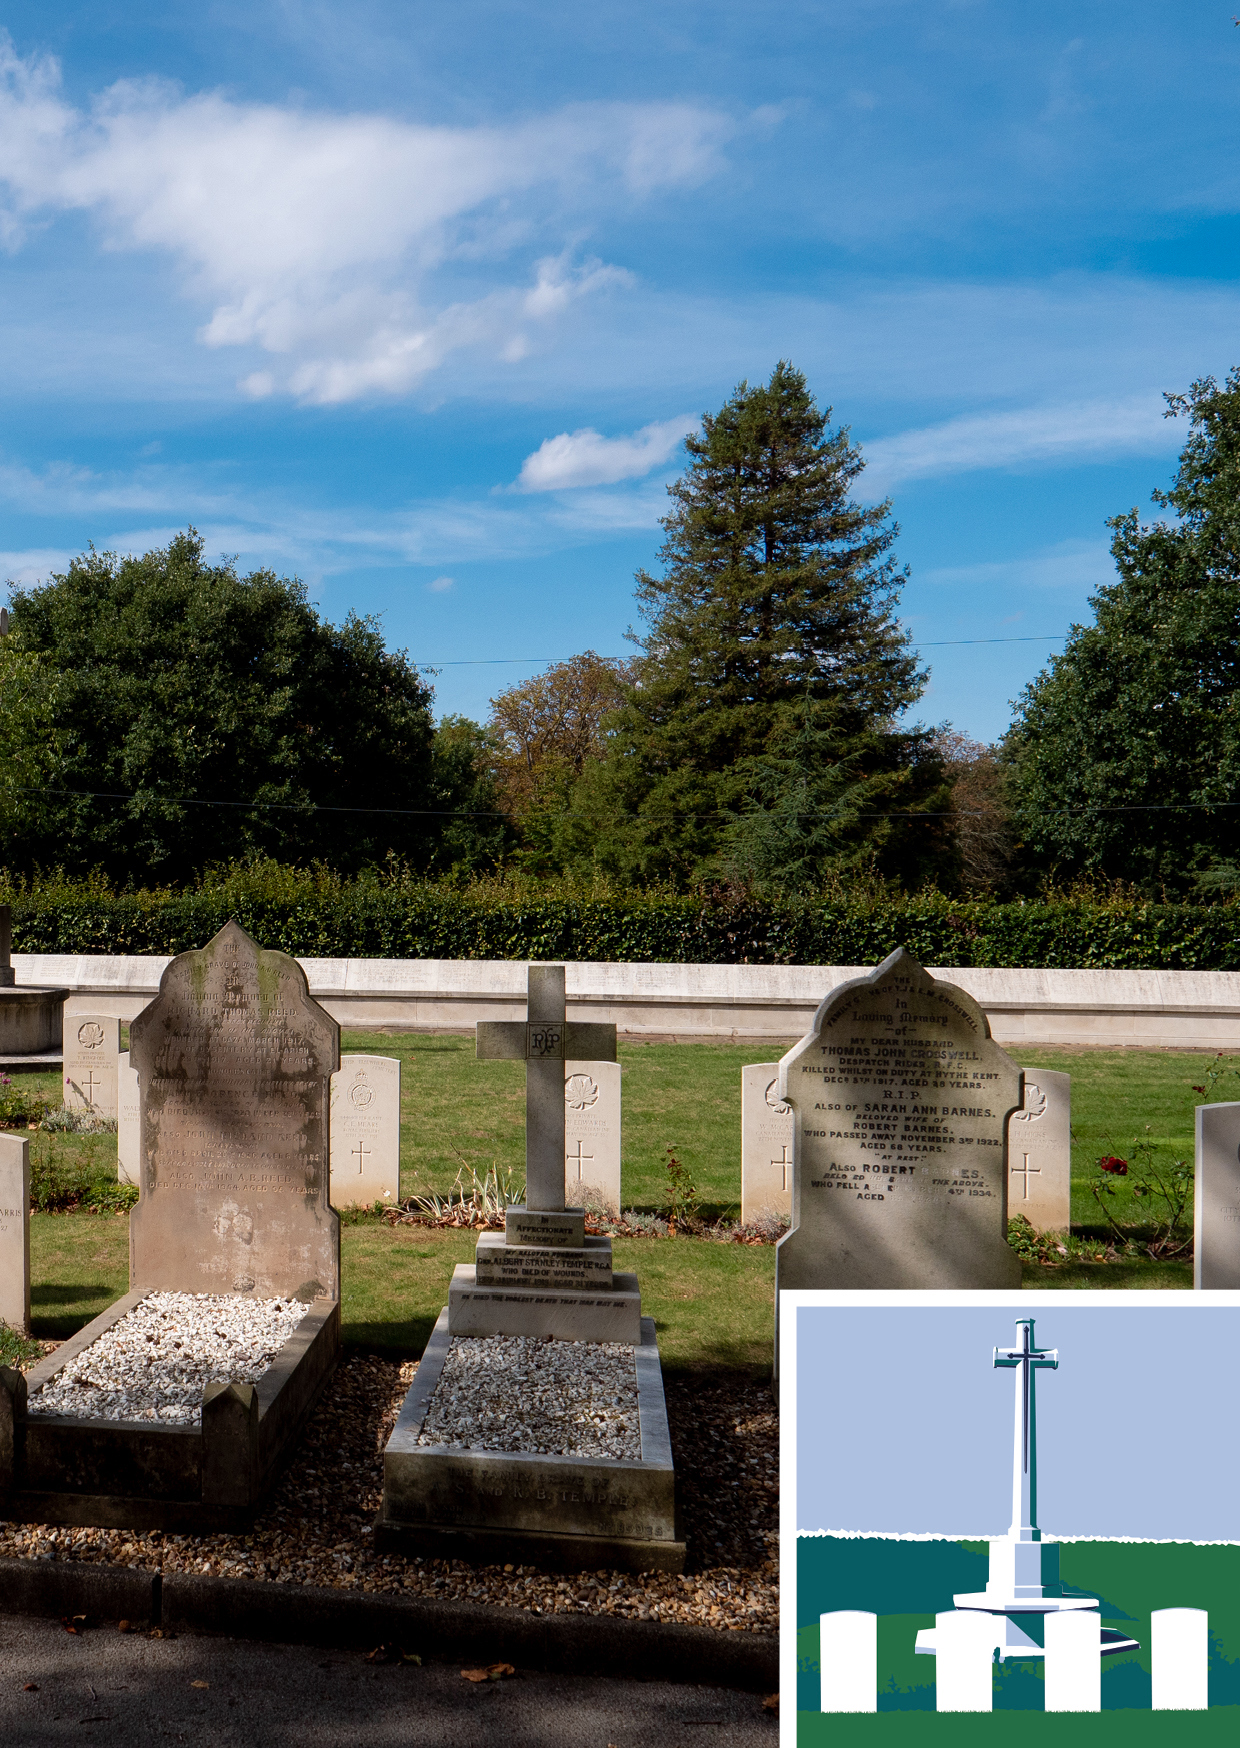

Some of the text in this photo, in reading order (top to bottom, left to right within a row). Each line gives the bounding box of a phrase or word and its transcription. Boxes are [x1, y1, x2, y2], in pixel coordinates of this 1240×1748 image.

[852, 1012, 948, 1026] Loving Memory
[871, 1038, 899, 1046] DEAR
[821, 1046, 906, 1057] THOMAS JOHN
[839, 1058, 890, 1066] DESPATCH
[802, 1066, 835, 1074] KILLED
[839, 1067, 873, 1075] WHILST
[891, 1069, 917, 1077] DUTY
[935, 1071, 968, 1079] HYTHE
[901, 1079, 929, 1087] AGED
[815, 1103, 841, 1111] ALSO
[865, 1103, 907, 1114] SARAH
[912, 1105, 938, 1115] ANN
[942, 1107, 996, 1118] BARNES.
[856, 1114, 899, 1122] BELOVED
[854, 1122, 954, 1134] ROBERT BARNES.
[804, 1130, 826, 1138] WHO
[830, 1131, 867, 1139] PASSED
[901, 1134, 956, 1143] NOVEMBER
[860, 1142, 886, 1150] AGED
[908, 1144, 946, 1153] YEARS.
[863, 1164, 915, 1175] ROBERT
[811, 1180, 833, 1188] WHO
[836, 1182, 860, 1190] FELL
[857, 1192, 885, 1201] AGED
[525, 1259, 561, 1268] STANLEY
